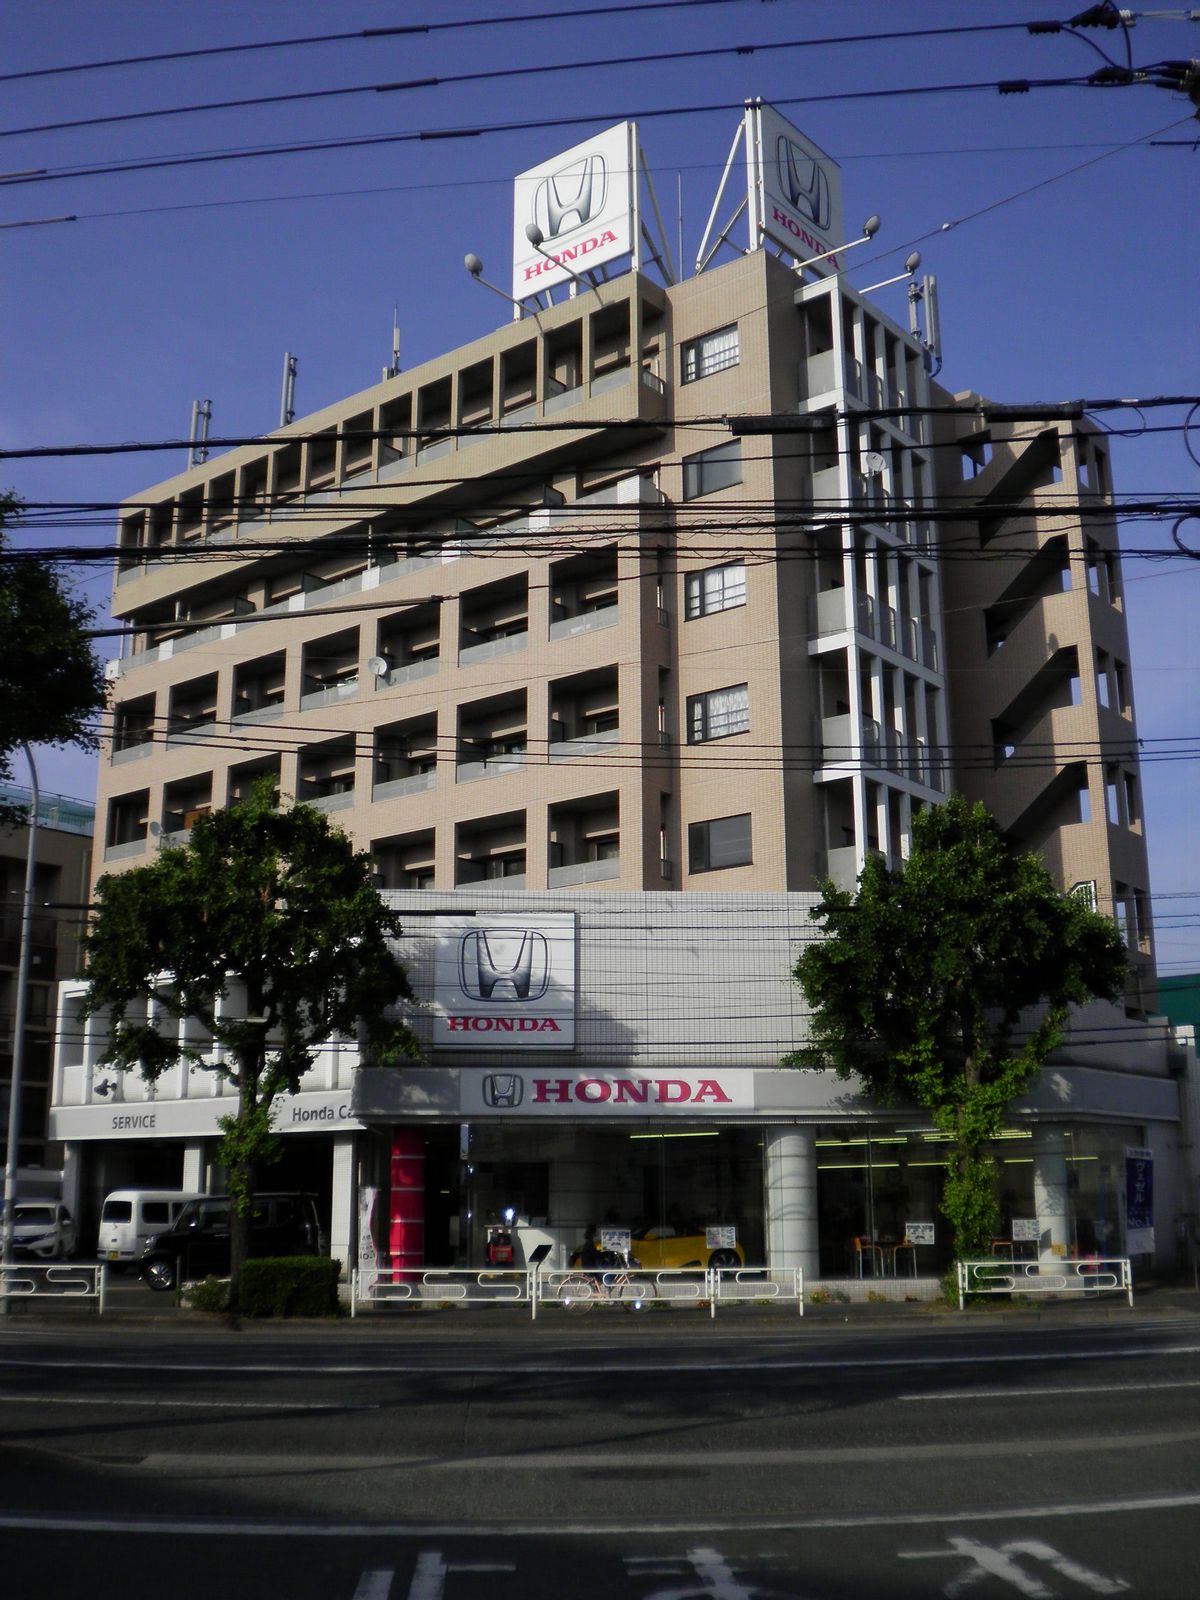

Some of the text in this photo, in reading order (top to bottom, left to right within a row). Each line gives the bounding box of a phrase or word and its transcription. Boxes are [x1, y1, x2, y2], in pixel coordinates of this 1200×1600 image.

[772, 206, 840, 271] HONDA
[523, 229, 618, 282] HONDA
[448, 1016, 561, 1032] HONDA
[532, 1079, 732, 1103] HONDA
[112, 1115, 156, 1129] SERVICE
[293, 1106, 334, 1121] Honda
